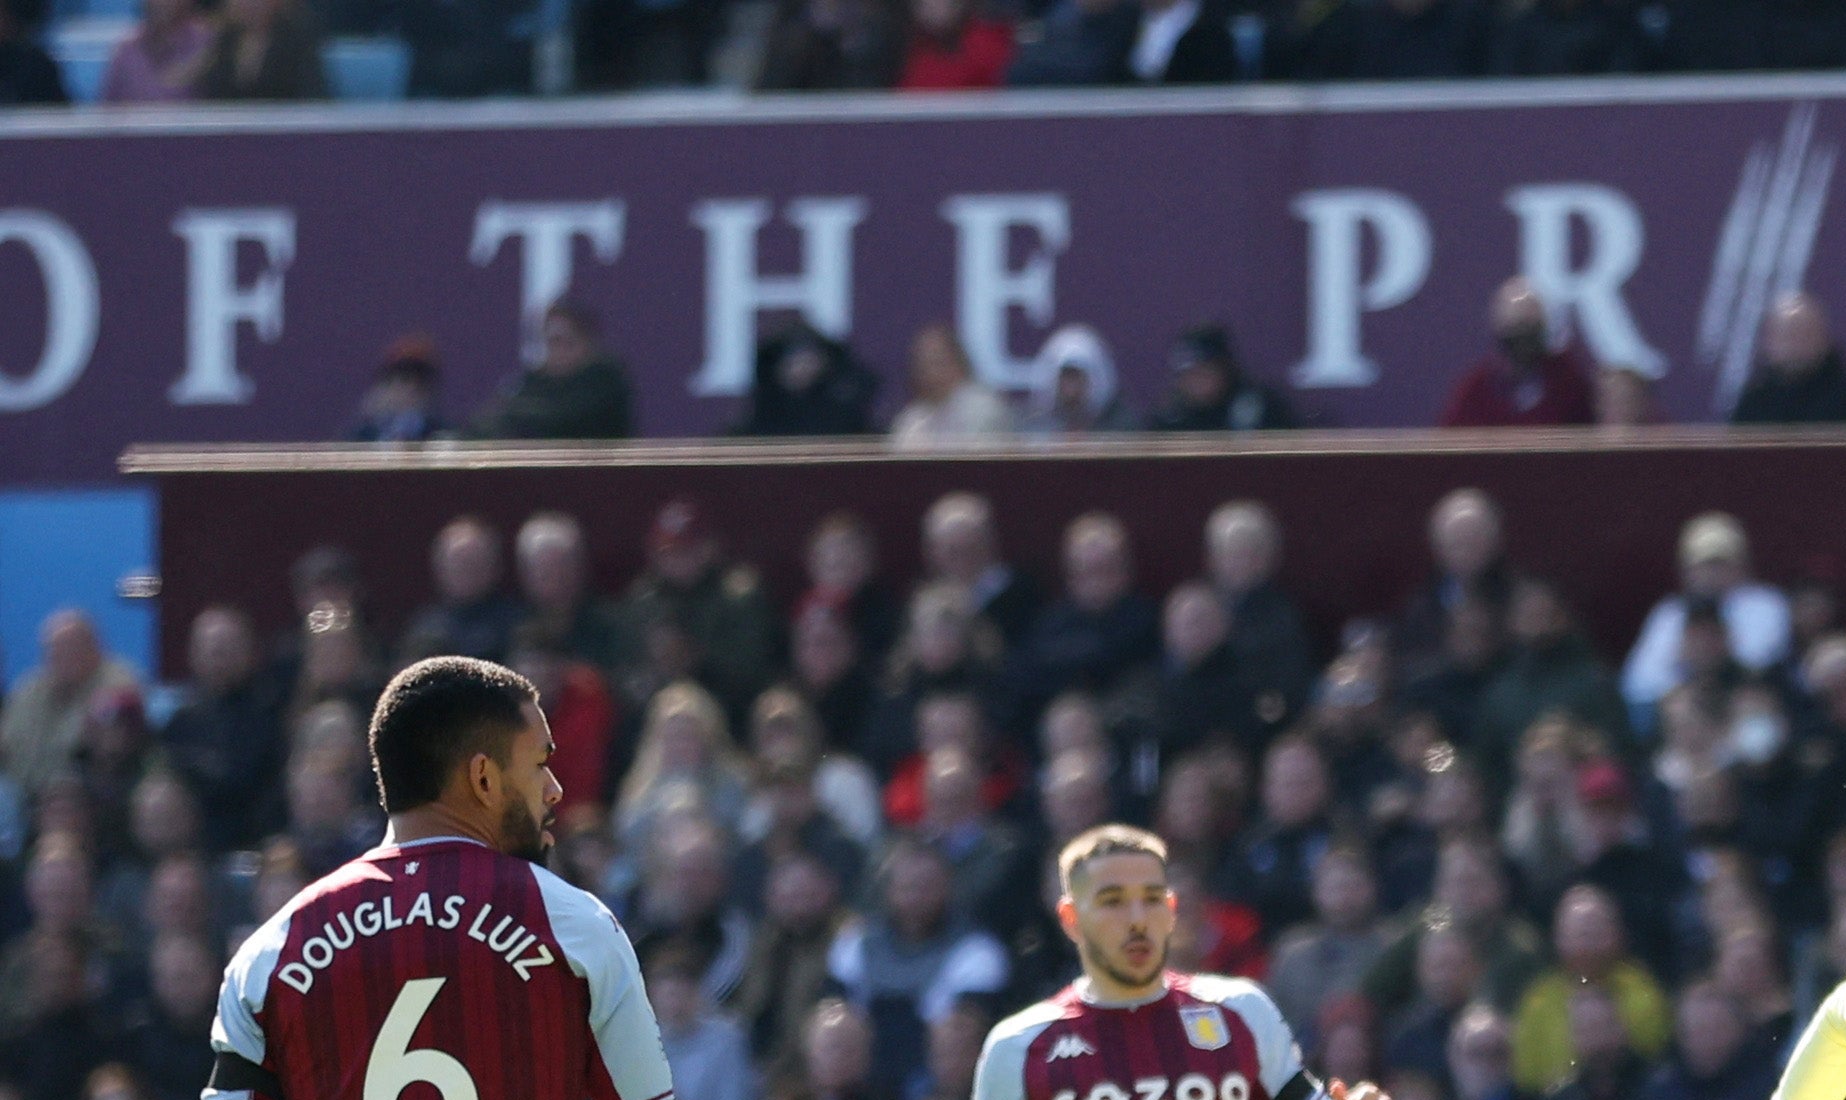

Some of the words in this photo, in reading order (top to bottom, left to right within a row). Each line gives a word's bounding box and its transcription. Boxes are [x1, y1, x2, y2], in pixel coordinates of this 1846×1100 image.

[468, 191, 1072, 397] THE
[277, 891, 466, 995] DOUGLAS
[467, 903, 556, 982] LUIZ
